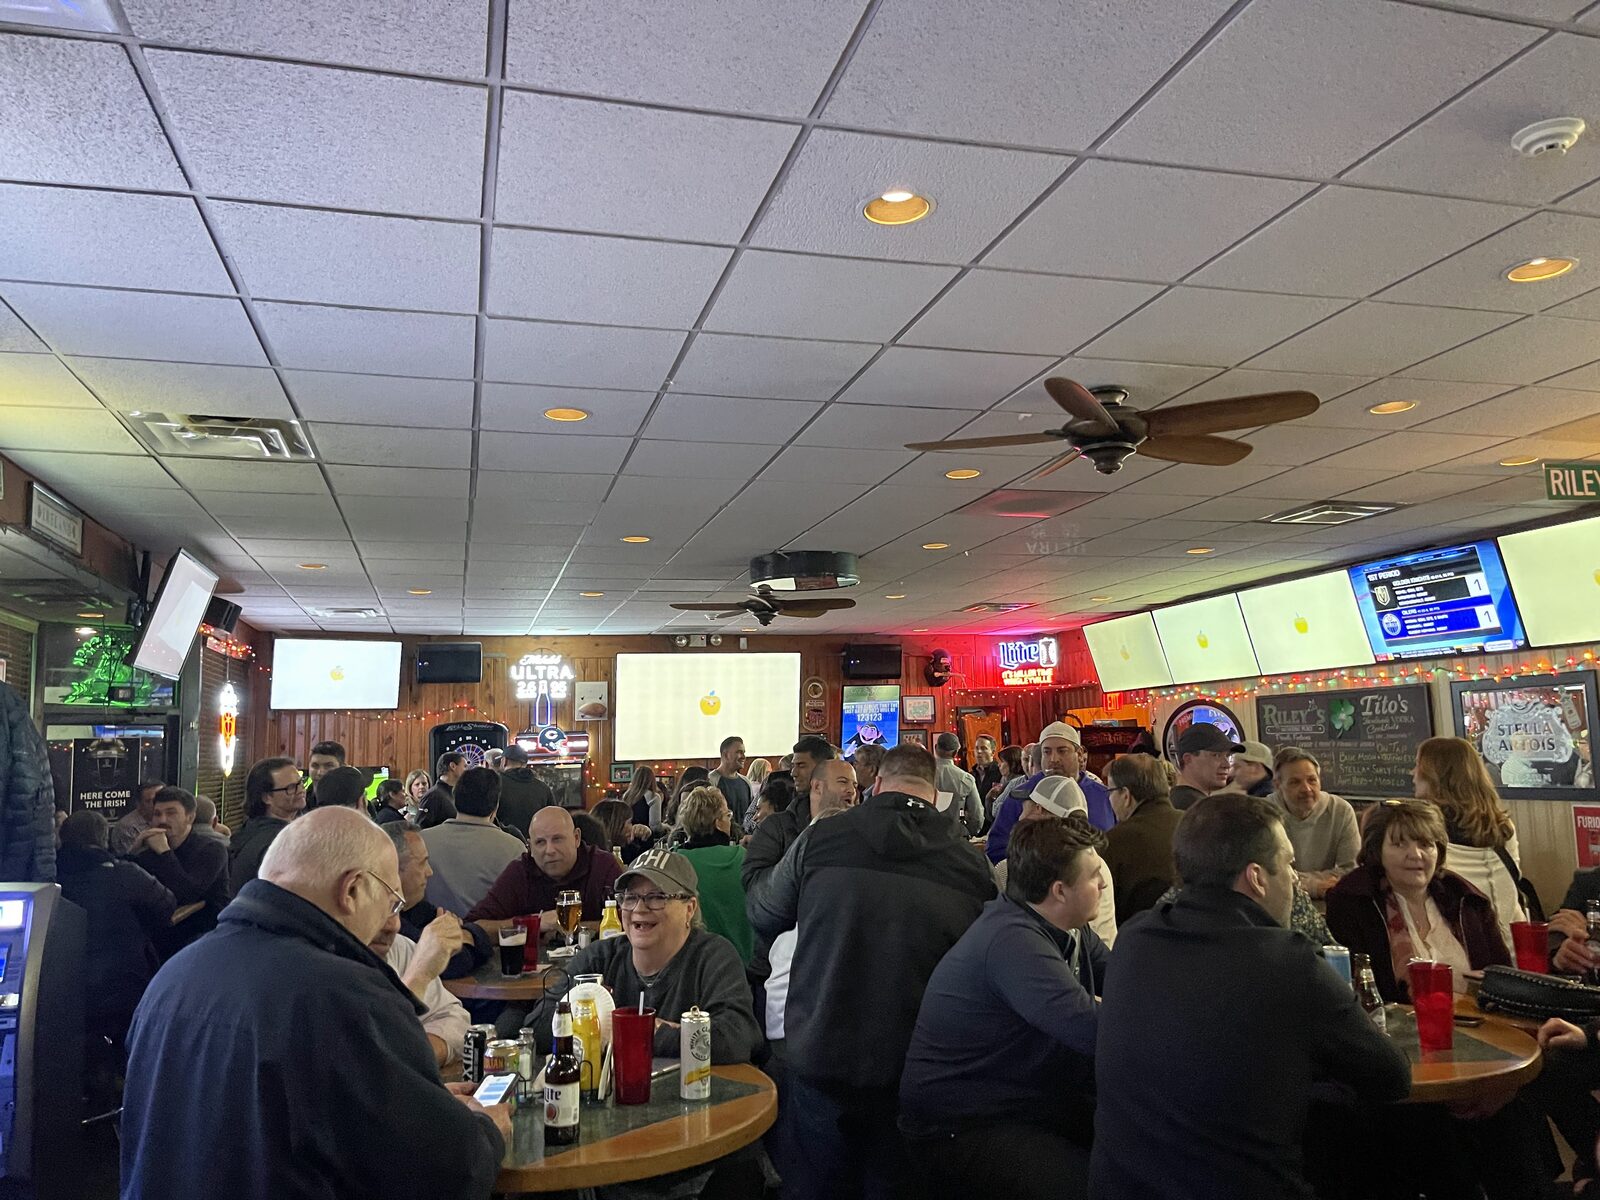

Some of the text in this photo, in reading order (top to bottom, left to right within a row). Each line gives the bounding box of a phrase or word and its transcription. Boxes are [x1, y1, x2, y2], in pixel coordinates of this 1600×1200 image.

[1378, 569, 1400, 579] PERIOD
[1474, 579, 1481, 590] 1
[1484, 611, 1491, 622] 1
[999, 641, 1039, 670] Lite
[510, 665, 575, 680] ULTRA
[1107, 692, 1120, 710] EXIT
[1360, 694, 1409, 716] Tito's
[857, 713, 882, 721] 123123
[1262, 700, 1326, 728] RILEY'S
[1498, 722, 1553, 737] STELLA
[1499, 738, 1555, 751] ARTOIS
[80, 790, 131, 800] HERE COME
[104, 799, 126, 808] IRISH
[633, 850, 671, 869] CHI
